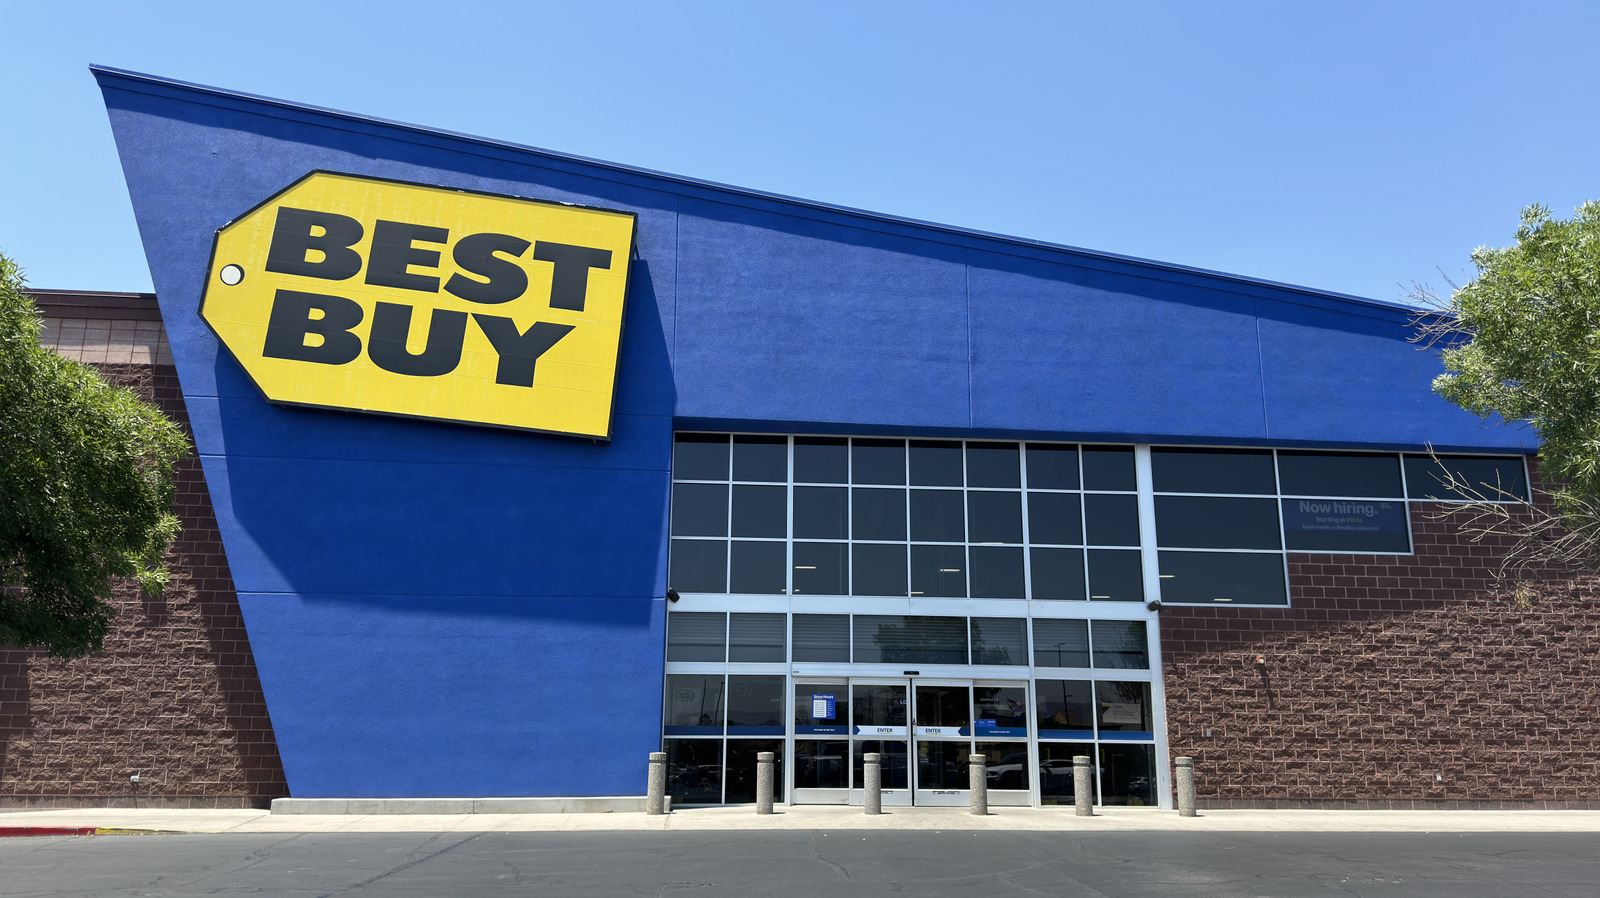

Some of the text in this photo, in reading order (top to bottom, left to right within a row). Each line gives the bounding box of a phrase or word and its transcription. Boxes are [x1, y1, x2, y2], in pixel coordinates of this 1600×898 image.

[265, 206, 613, 311] BEST
[262, 289, 576, 388] BUY
[1299, 501, 1331, 513] Now
[1334, 501, 1378, 517] hiring.
[1316, 516, 1339, 524] Starting
